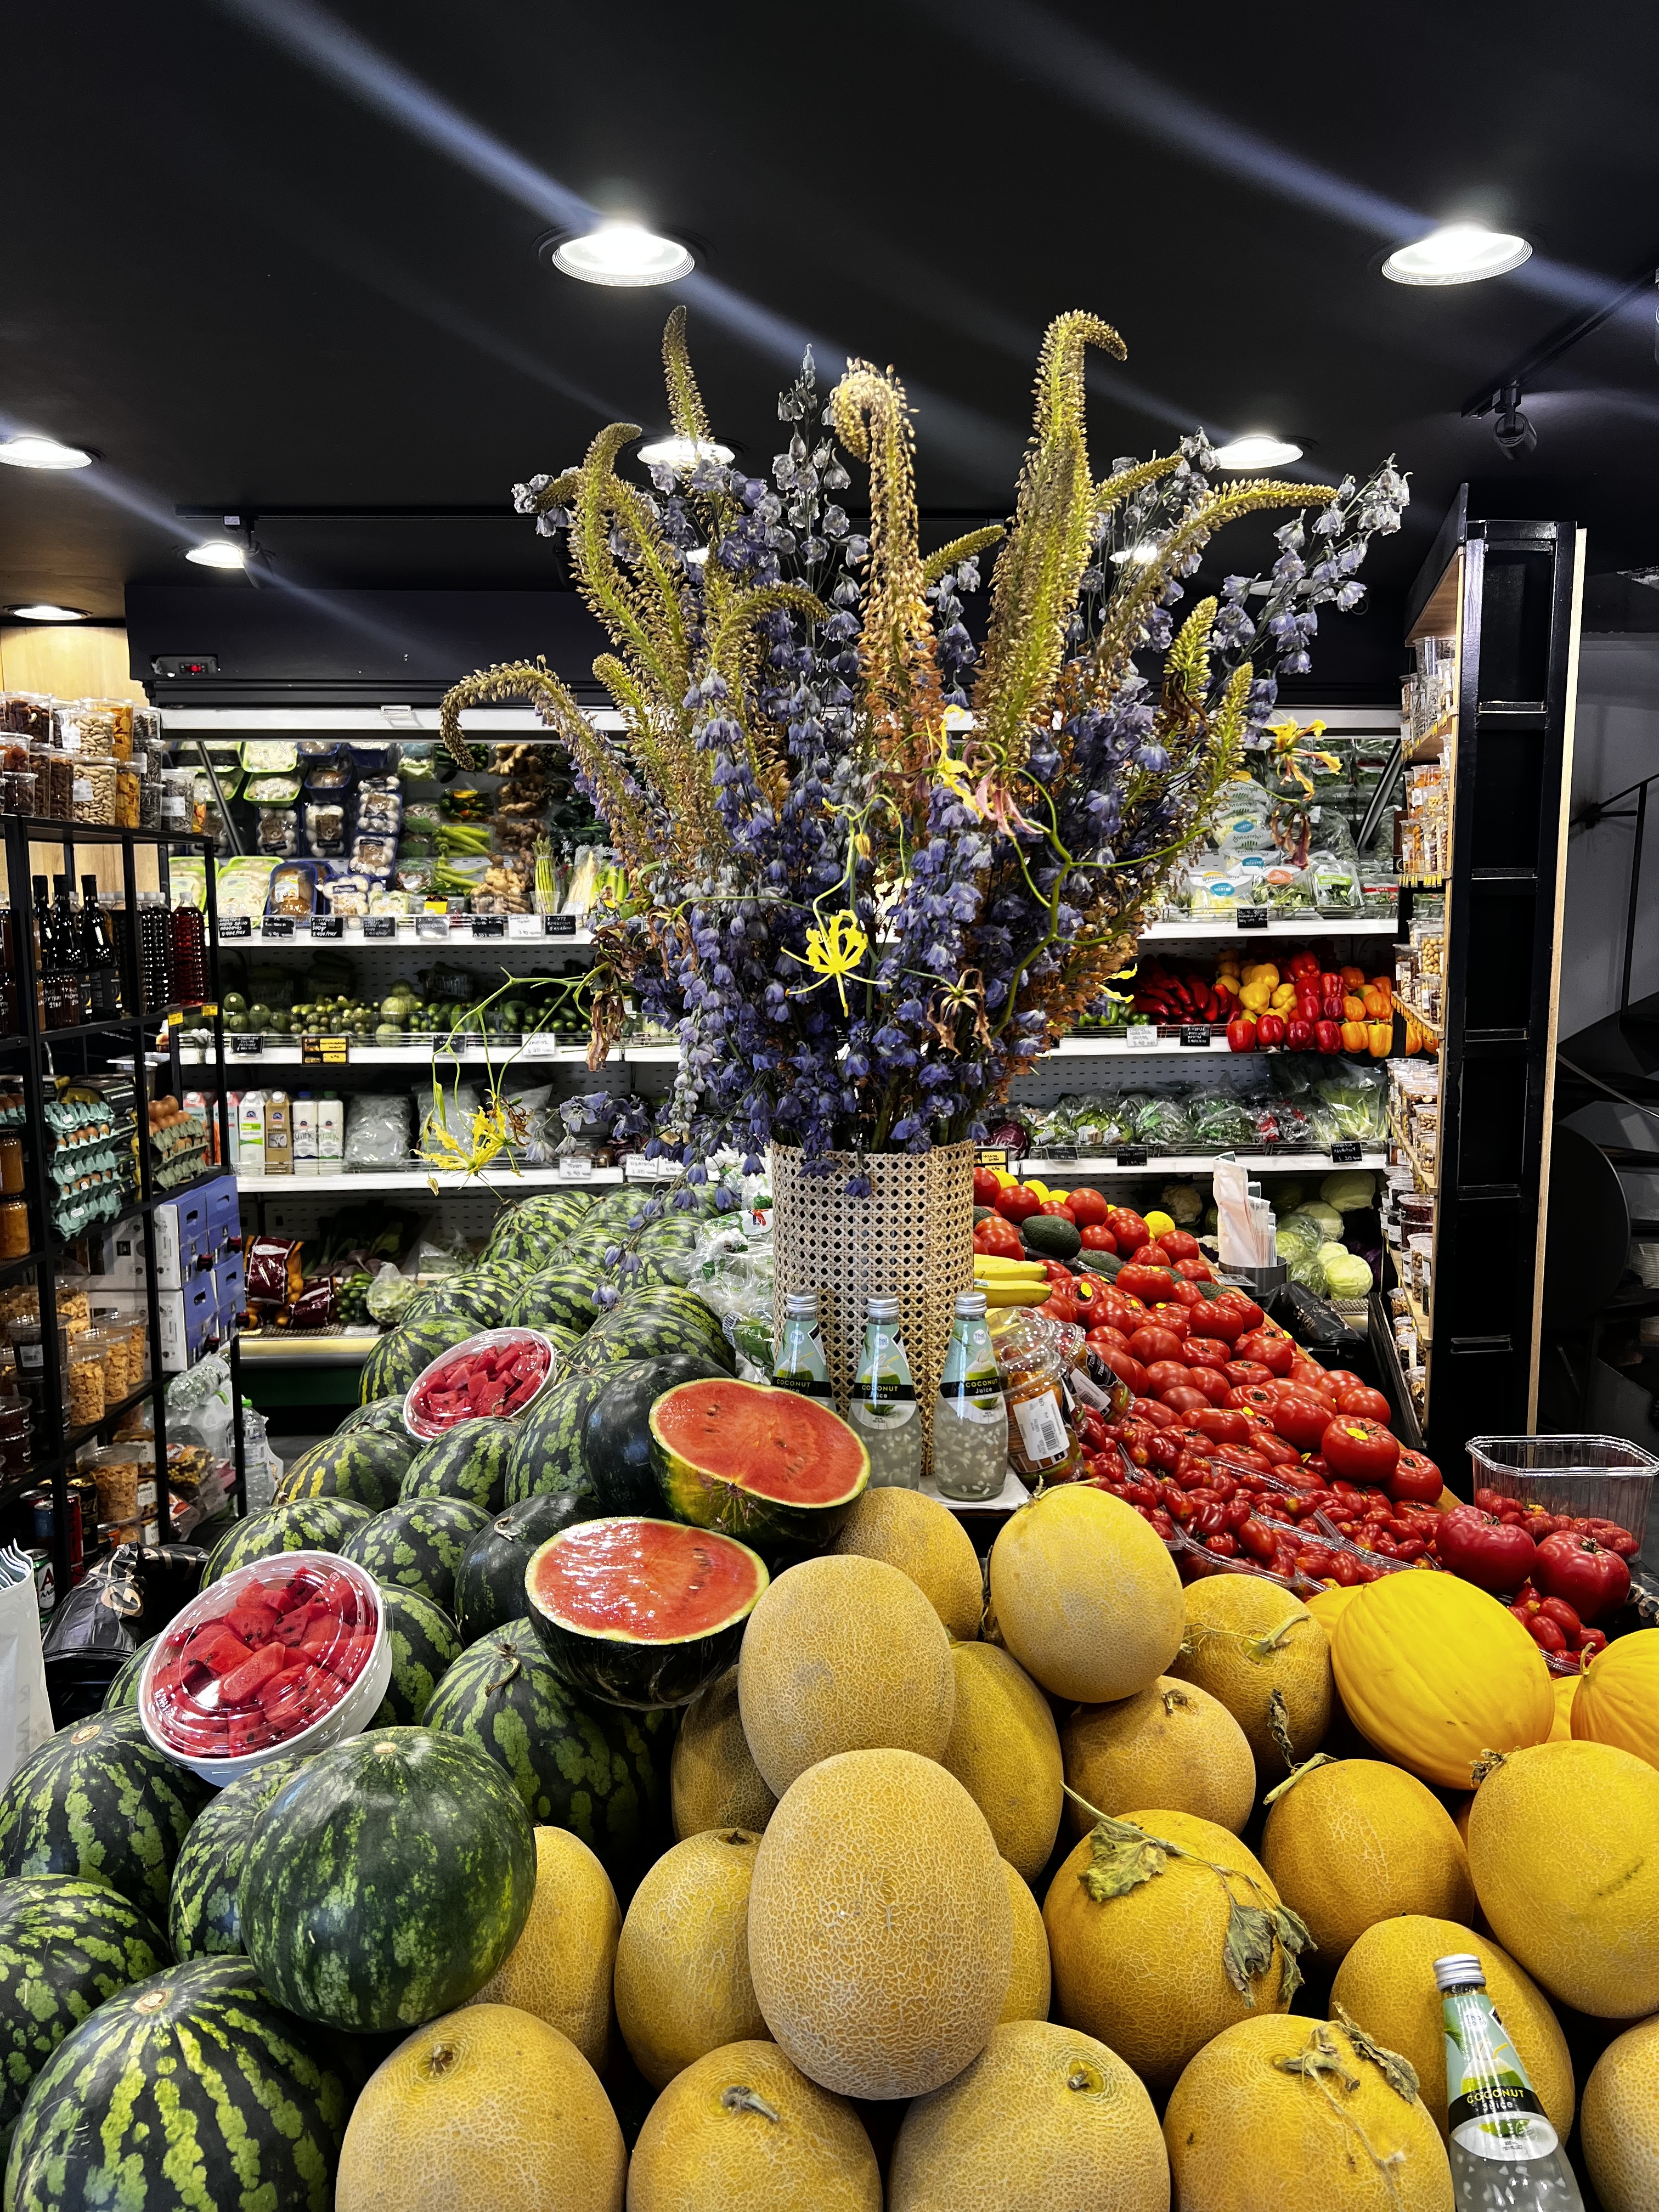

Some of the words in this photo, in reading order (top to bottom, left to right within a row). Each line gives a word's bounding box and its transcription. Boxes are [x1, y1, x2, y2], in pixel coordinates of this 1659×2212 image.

[776, 1379, 811, 1387] COCONUT
[965, 1378, 998, 1388] COCONUT
[1466, 2089, 1524, 2104] COCONUT
